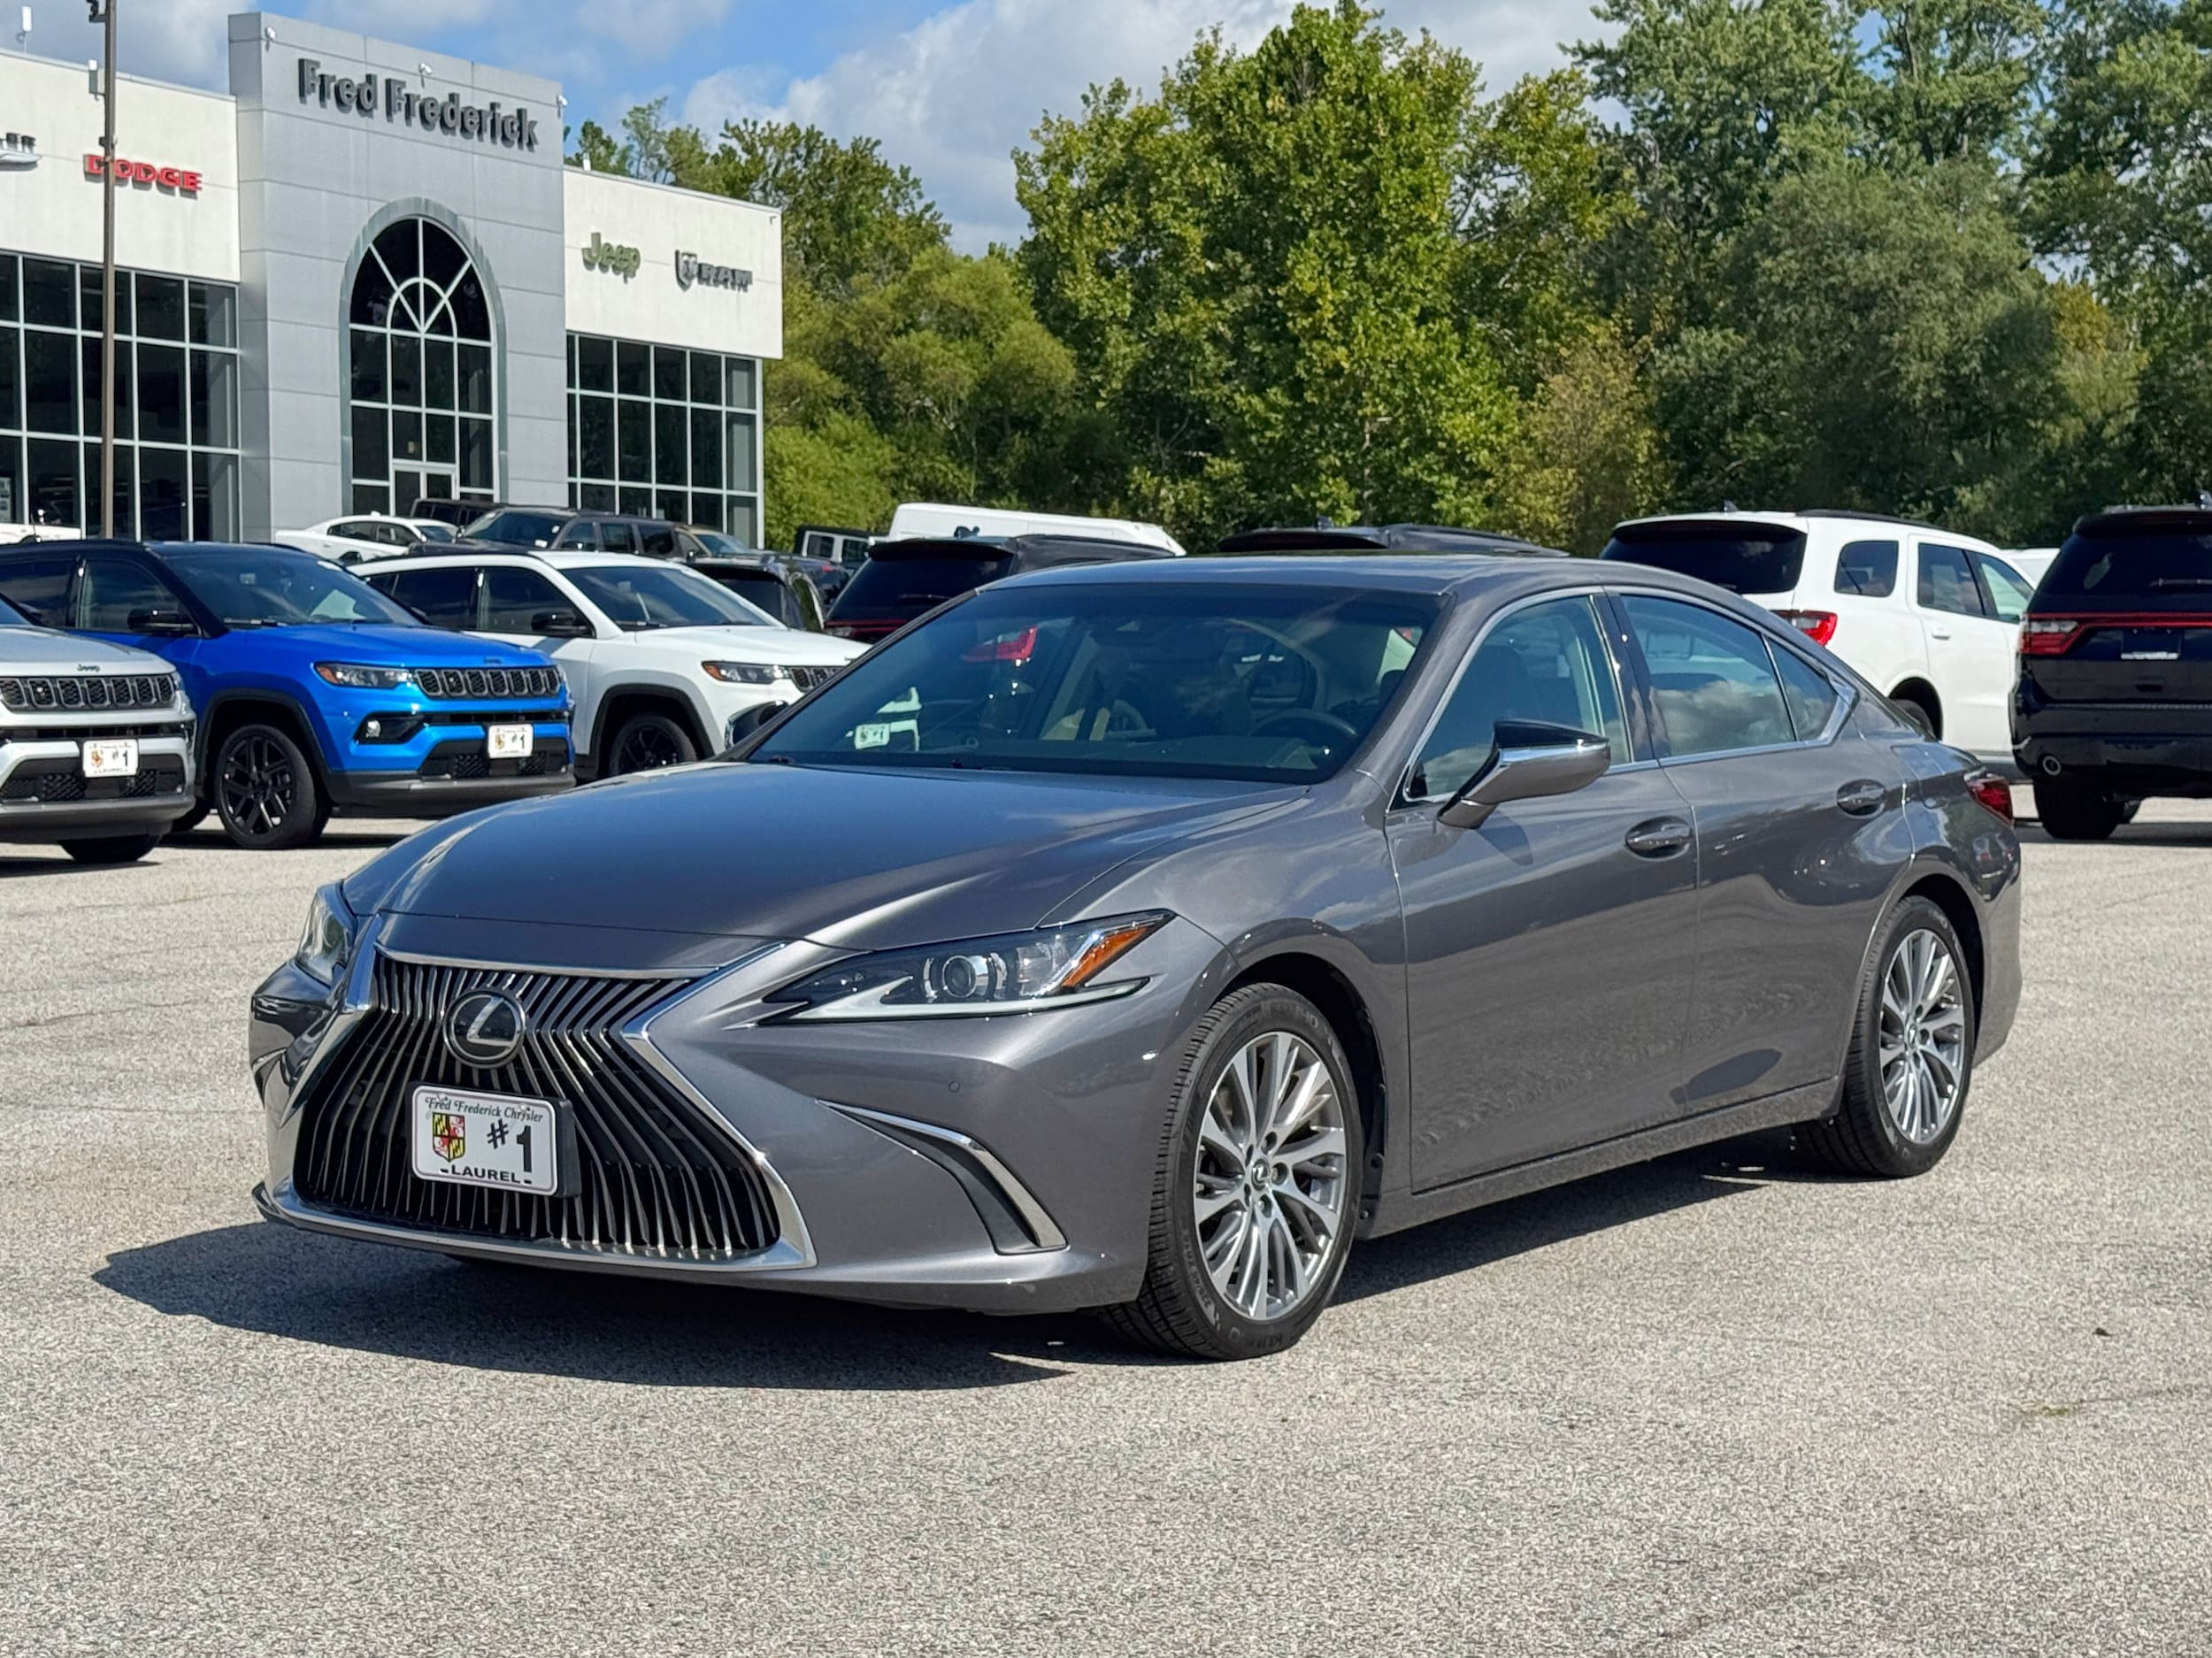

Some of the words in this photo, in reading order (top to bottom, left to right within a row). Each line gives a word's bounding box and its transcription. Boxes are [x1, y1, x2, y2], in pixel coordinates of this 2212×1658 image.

[298, 58, 378, 116] Fred
[385, 78, 538, 150] Frederick
[83, 154, 203, 191] DODGE
[582, 232, 641, 280] Jeep
[697, 263, 752, 291] RAM
[425, 1096, 451, 1111] Fred
[454, 1101, 502, 1117] Frederick
[503, 1107, 544, 1123] Chrysler
[451, 1164, 521, 1185] LAUREL
